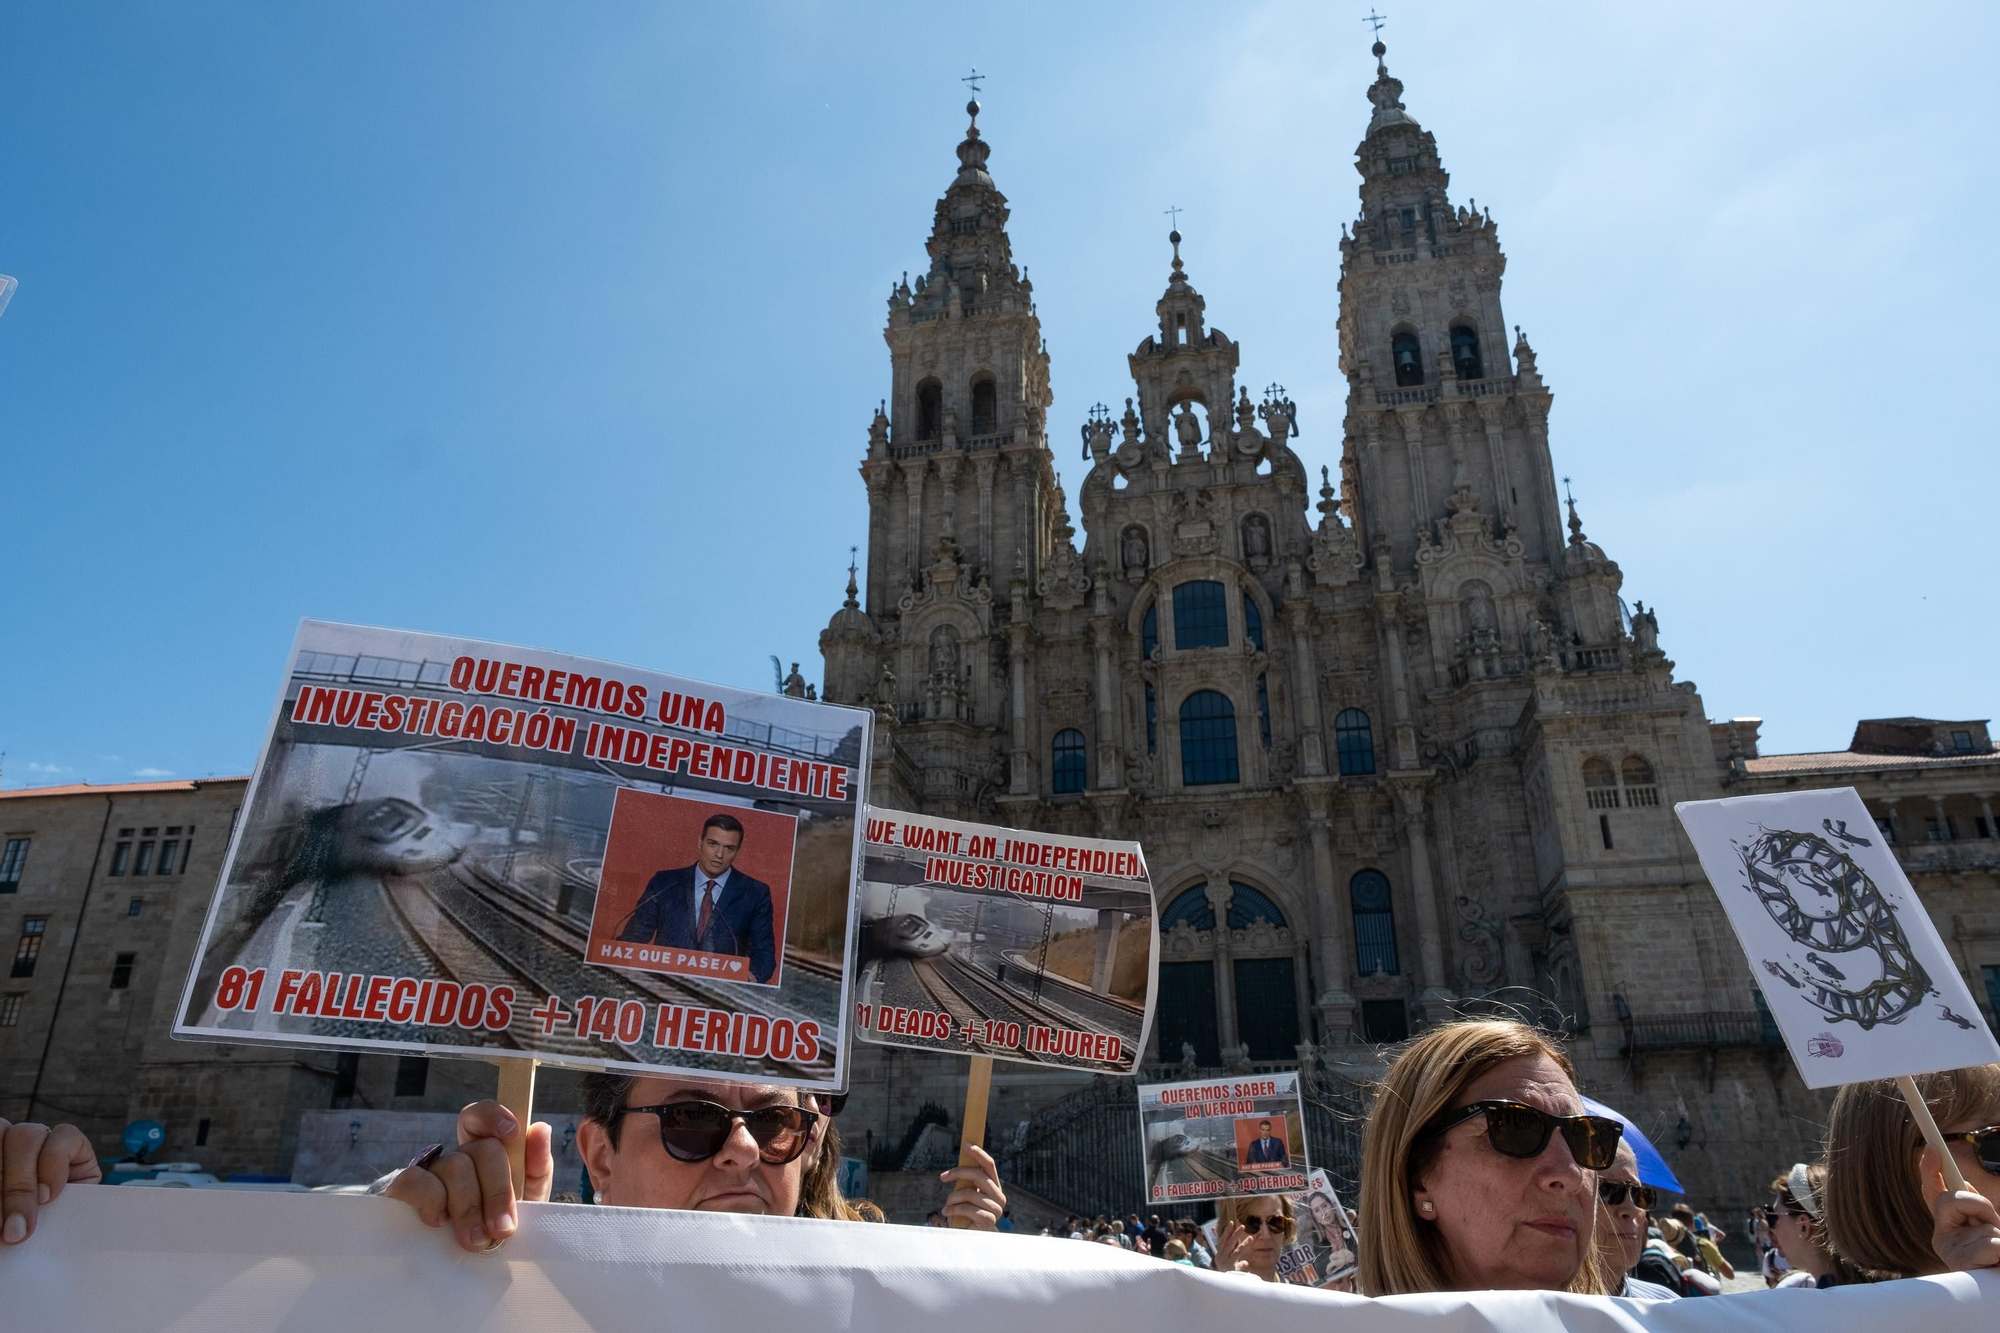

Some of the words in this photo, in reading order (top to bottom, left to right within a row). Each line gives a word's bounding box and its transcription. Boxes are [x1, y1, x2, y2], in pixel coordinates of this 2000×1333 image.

[449, 656, 648, 718] QUEREMOS
[659, 691, 725, 734] UNA
[291, 686, 576, 753] INVESTIGACIÓN
[585, 723, 848, 800] INDEPENDIENTE
[866, 817, 897, 845] WE
[902, 824, 963, 855] WANT
[968, 834, 997, 861] AN
[1003, 839, 1145, 878] INDEPENDIEN
[924, 857, 1083, 901] INVESTIGATION
[600, 943, 635, 960] HAZ
[638, 948, 672, 964] QUE
[216, 966, 265, 1010] 81
[272, 970, 514, 1029] FALLECIDOS
[655, 1005, 820, 1062] HERIDOS
[877, 1006, 951, 1040] DEADS
[1026, 1026, 1122, 1062] INJURED
[1161, 1085, 1230, 1105] QUEREMOS
[1234, 1081, 1276, 1098] SABER
[1185, 1105, 1201, 1119] LA
[1204, 1100, 1254, 1117] VERDAD
[1153, 1185, 1164, 1197] 81
[1167, 1181, 1224, 1196] FALLECIDOS
[1260, 1175, 1304, 1189] HERIDOS
